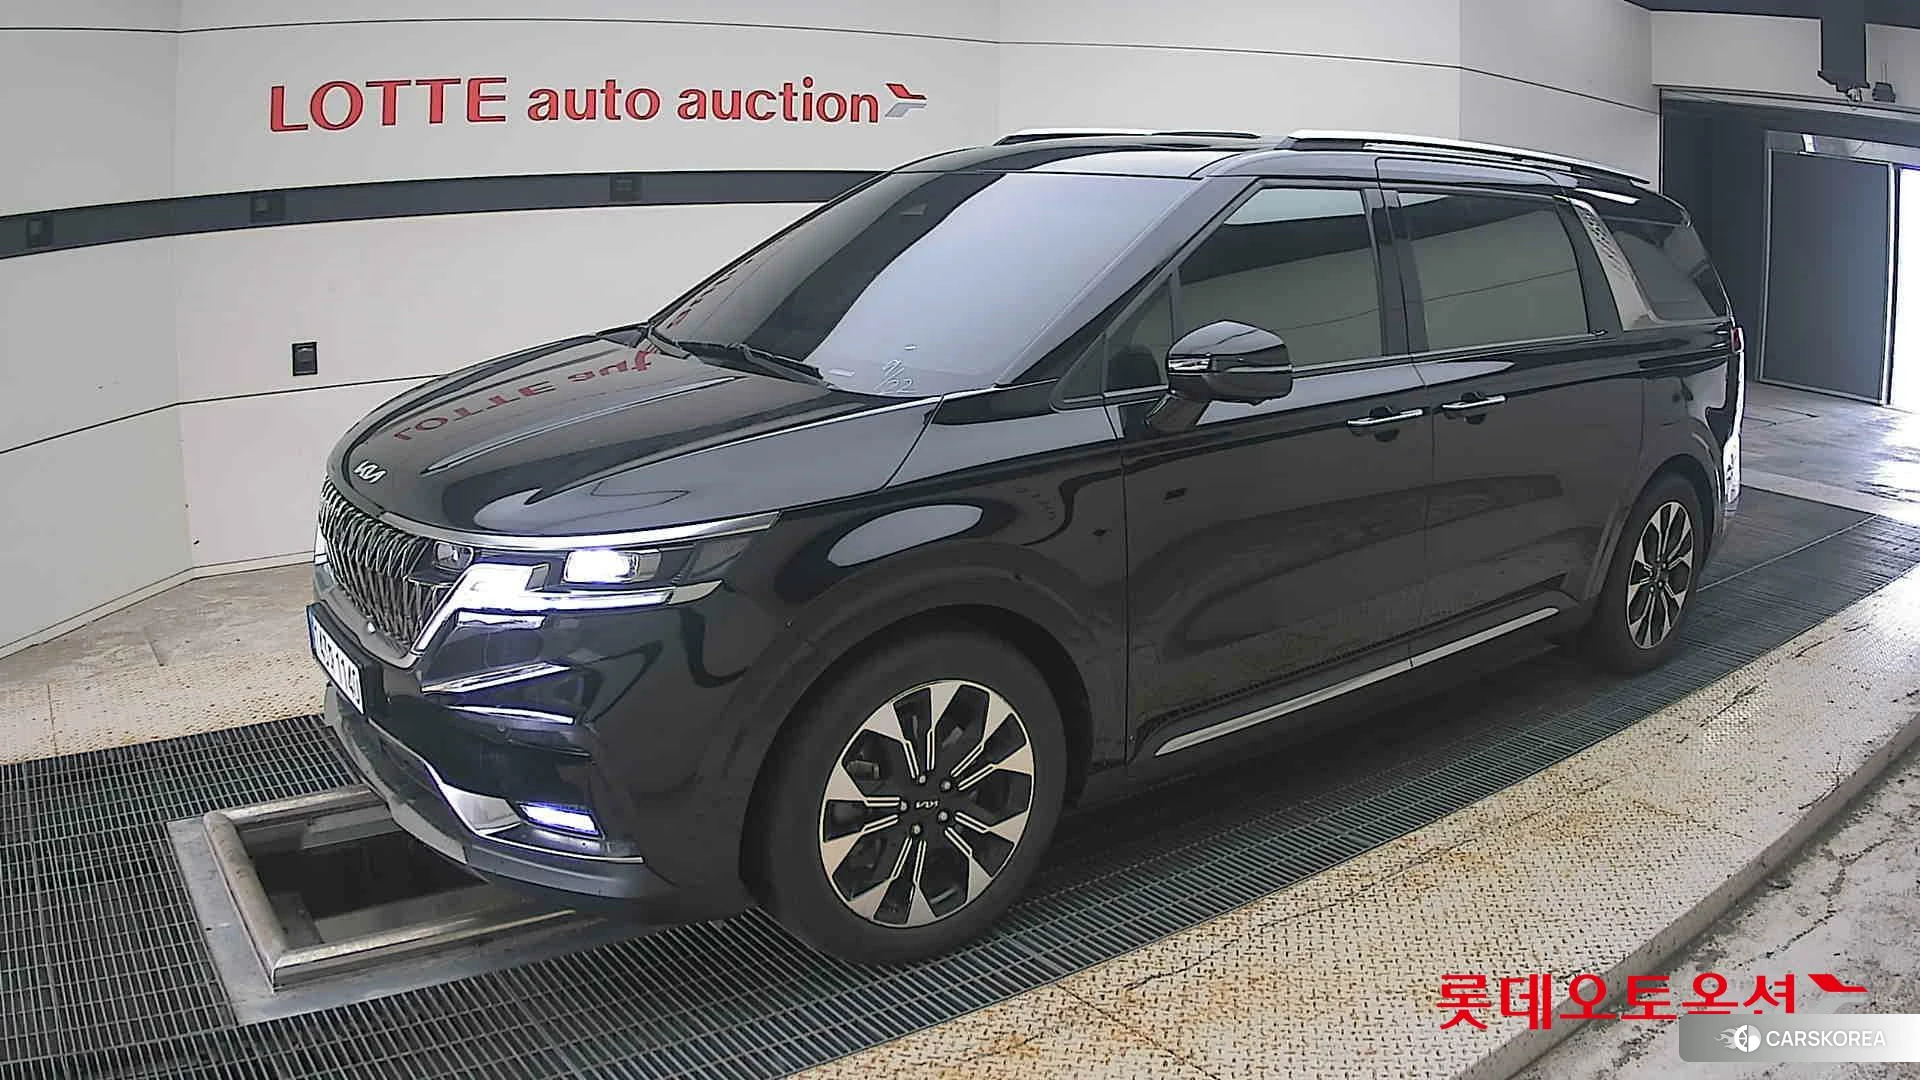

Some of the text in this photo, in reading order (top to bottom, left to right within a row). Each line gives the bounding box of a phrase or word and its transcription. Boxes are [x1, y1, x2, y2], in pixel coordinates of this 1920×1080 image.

[271, 76, 879, 132] LOTTE auto auction
